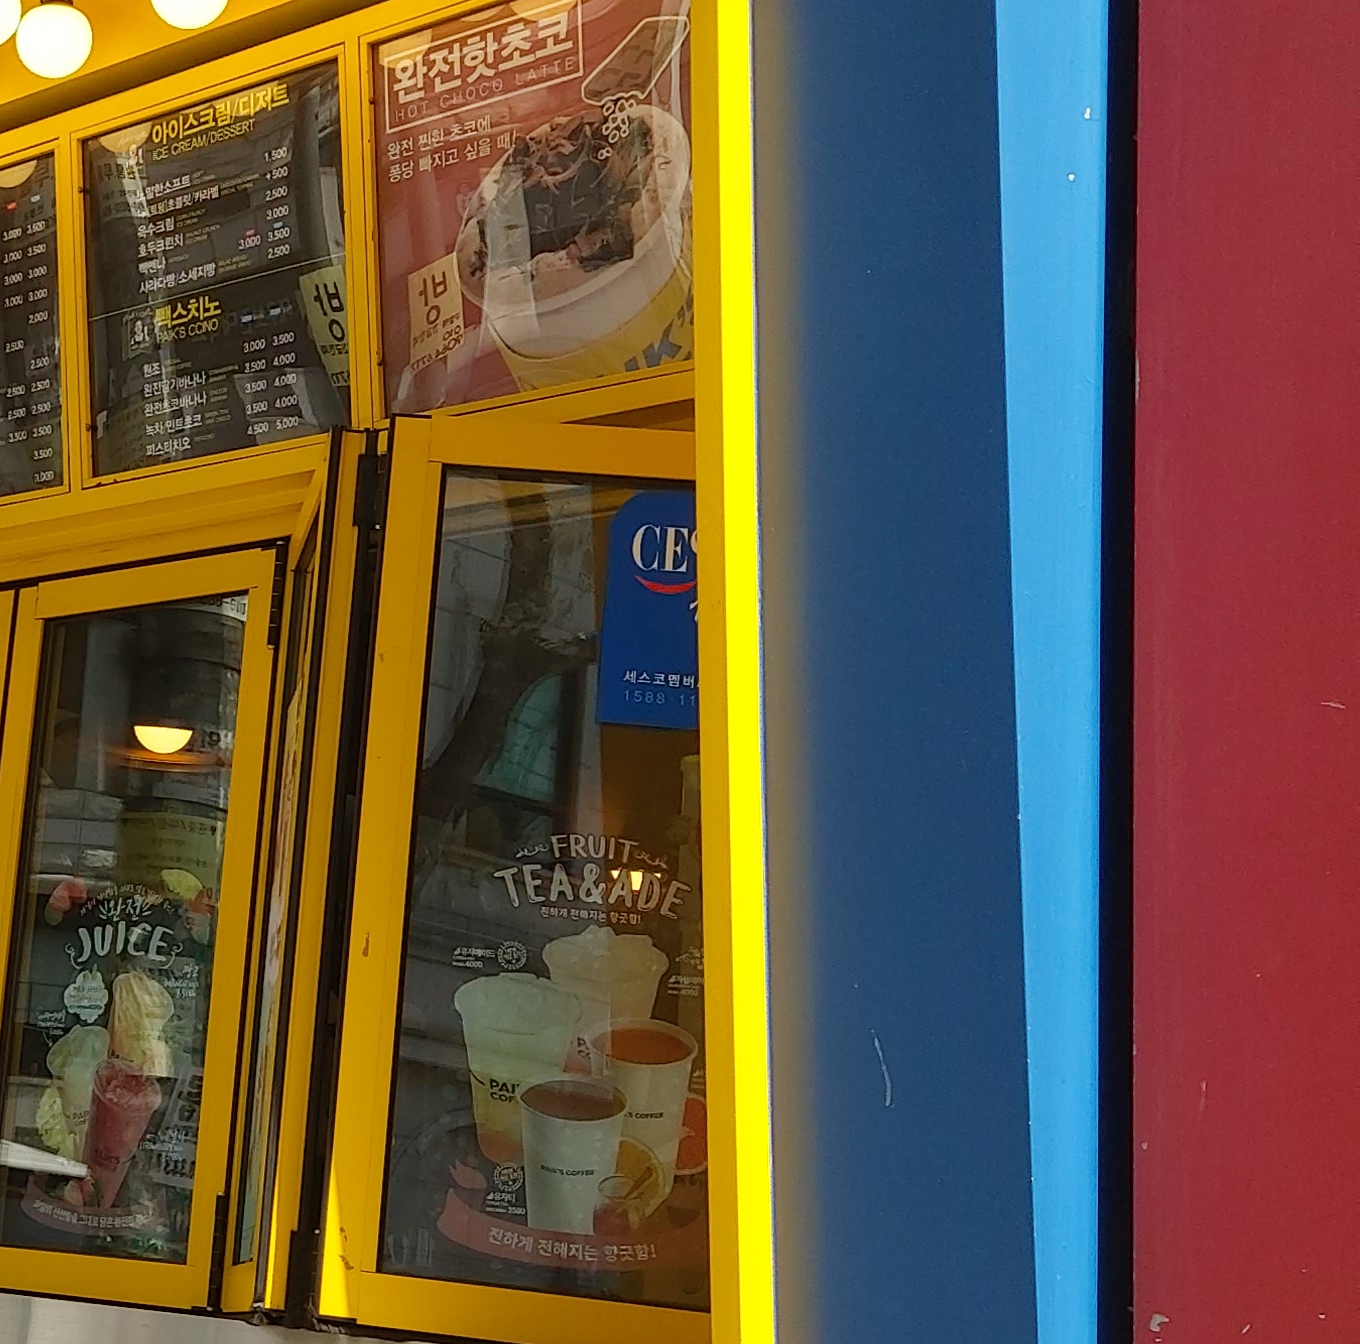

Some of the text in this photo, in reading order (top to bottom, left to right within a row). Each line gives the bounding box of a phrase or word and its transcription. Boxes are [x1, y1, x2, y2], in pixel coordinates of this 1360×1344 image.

[393, 11, 574, 104] 완전핫초코
[395, 56, 575, 122] HOT CHOCO LATTE
[152, 83, 290, 144] 아이스크림/디저트
[152, 118, 256, 161] ICE CREAM/DESSERT
[387, 137, 414, 161] 완전
[449, 114, 490, 141] 초코에
[388, 128, 517, 183] 퐁당 빠지고 싶을 때!
[138, 233, 184, 258] 호두크런치
[155, 296, 222, 328] 빽스치노
[156, 318, 219, 346] PAIK'S CCINO
[143, 362, 161, 378] 원조
[143, 390, 207, 417] 완전초코바나나
[623, 670, 698, 688] 세스코멤버
[550, 834, 639, 863] FRUIT
[493, 862, 692, 920] TEA&ADE
[540, 906, 568, 918] 진하게
[77, 920, 174, 962] JUICE
[566, 1169, 595, 1177] COFFEE
[489, 1226, 657, 1263] 진하게 전해지는 향긋함!
